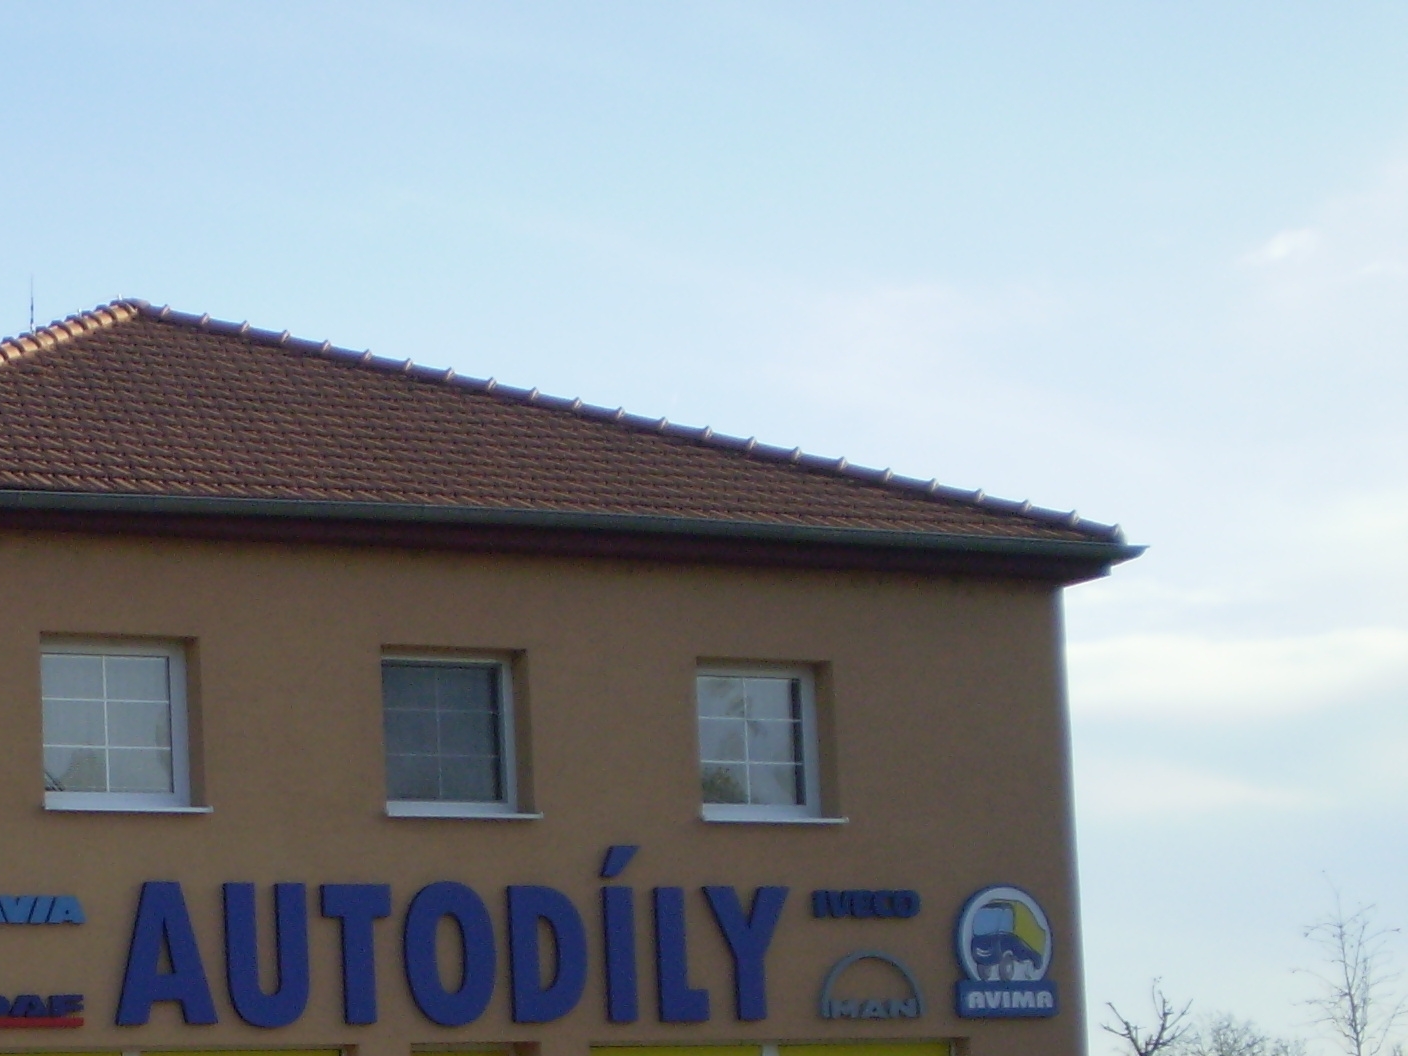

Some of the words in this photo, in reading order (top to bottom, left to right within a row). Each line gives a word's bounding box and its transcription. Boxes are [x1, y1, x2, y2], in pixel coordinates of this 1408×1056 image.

[812, 890, 920, 918] IVECO
[115, 845, 789, 1028] AUTODÍLY
[830, 998, 920, 1019] MAN
[967, 989, 1054, 1010] AVIMA
